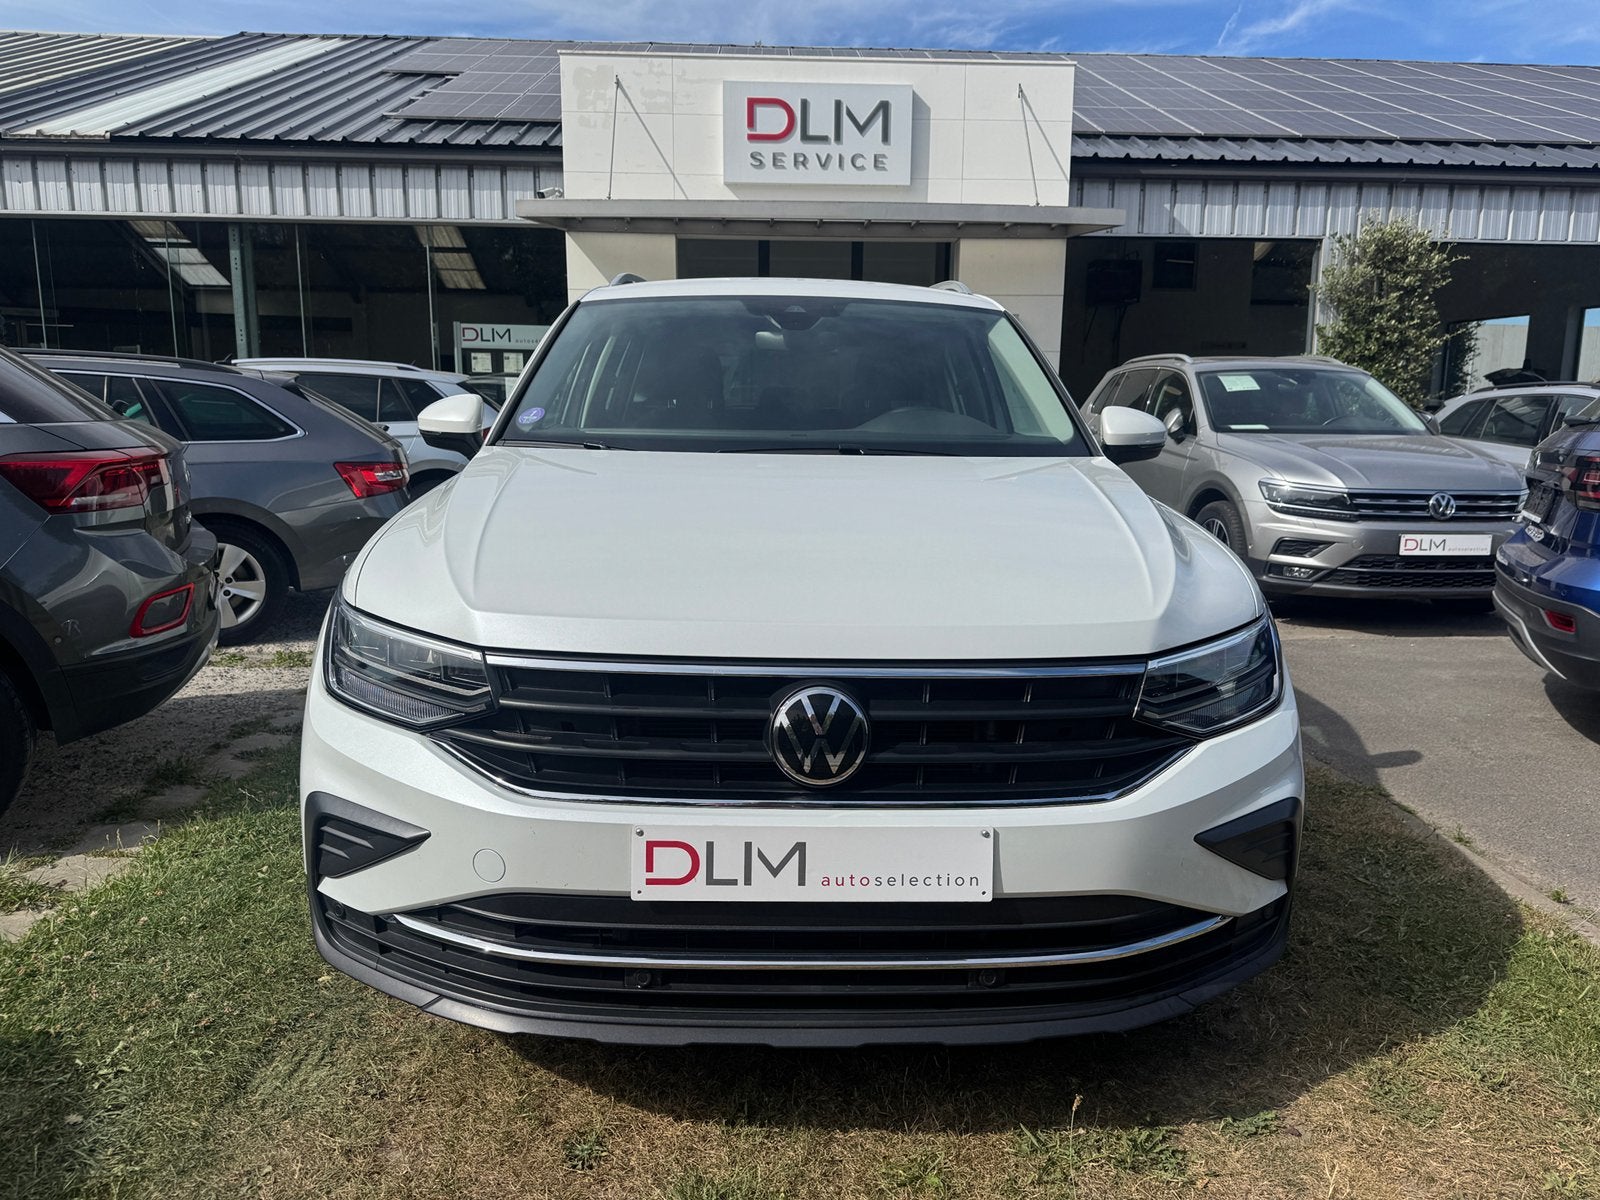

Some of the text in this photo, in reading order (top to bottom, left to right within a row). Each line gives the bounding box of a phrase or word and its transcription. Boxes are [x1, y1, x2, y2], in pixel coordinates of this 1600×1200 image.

[746, 97, 890, 143] DLM
[749, 151, 889, 171] SERVICE
[462, 327, 511, 342] DLM
[1403, 538, 1447, 552] DLM
[645, 840, 980, 887] DLM autoselection
